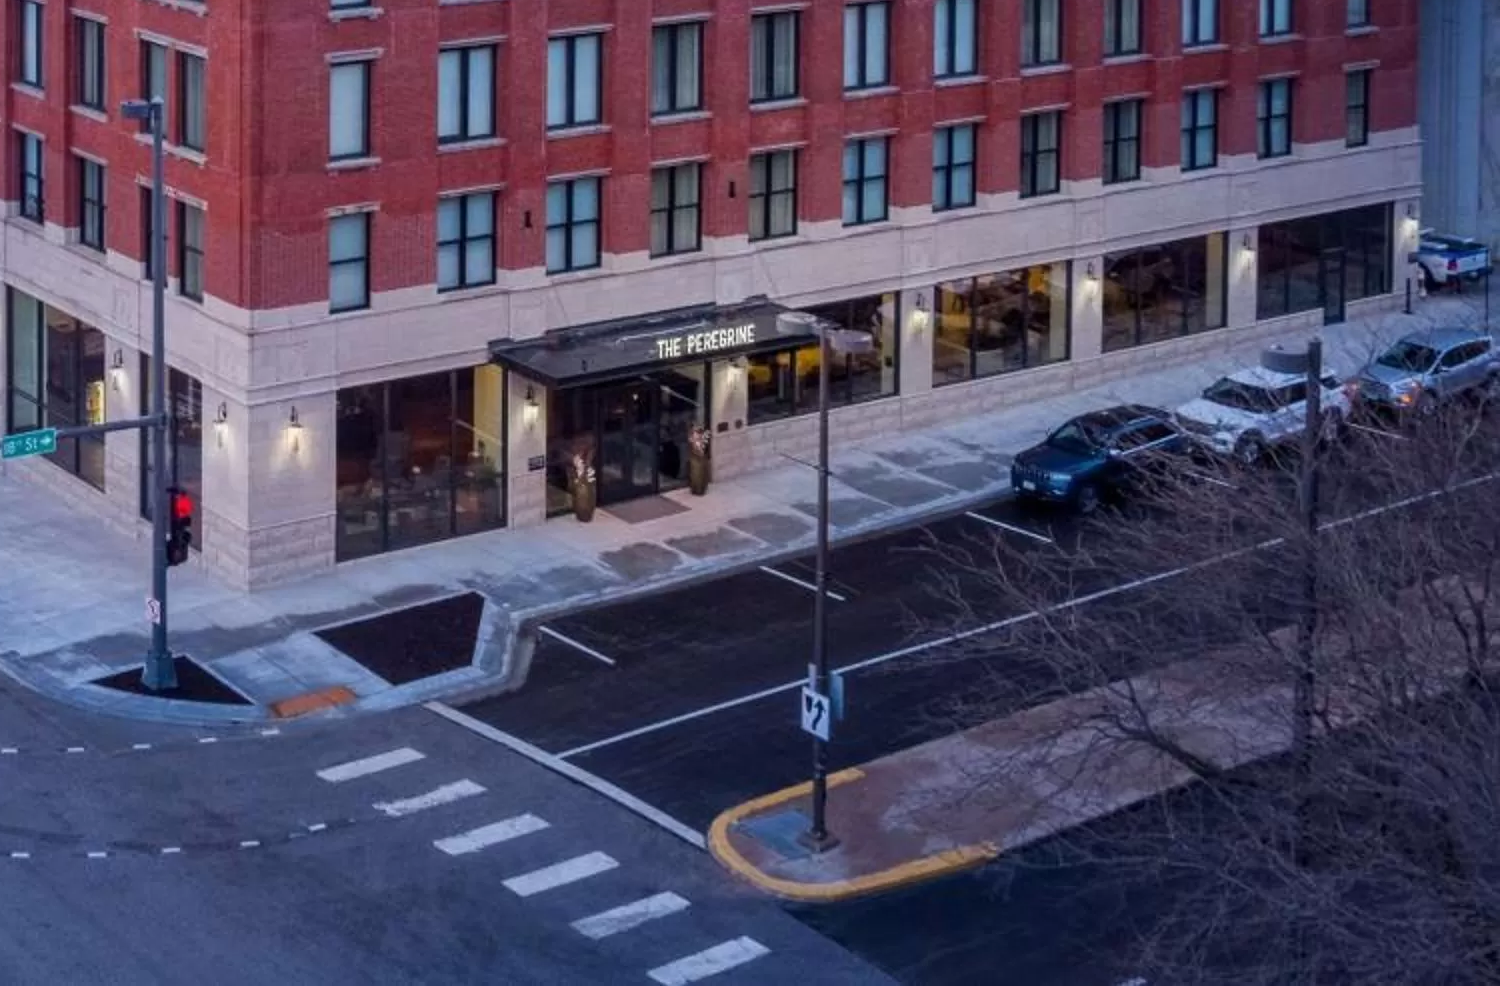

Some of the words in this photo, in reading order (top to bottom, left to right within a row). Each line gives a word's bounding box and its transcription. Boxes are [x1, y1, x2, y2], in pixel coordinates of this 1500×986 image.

[657, 337, 682, 358] THE
[687, 324, 756, 354] PEREGRINE
[25, 437, 38, 451] St
